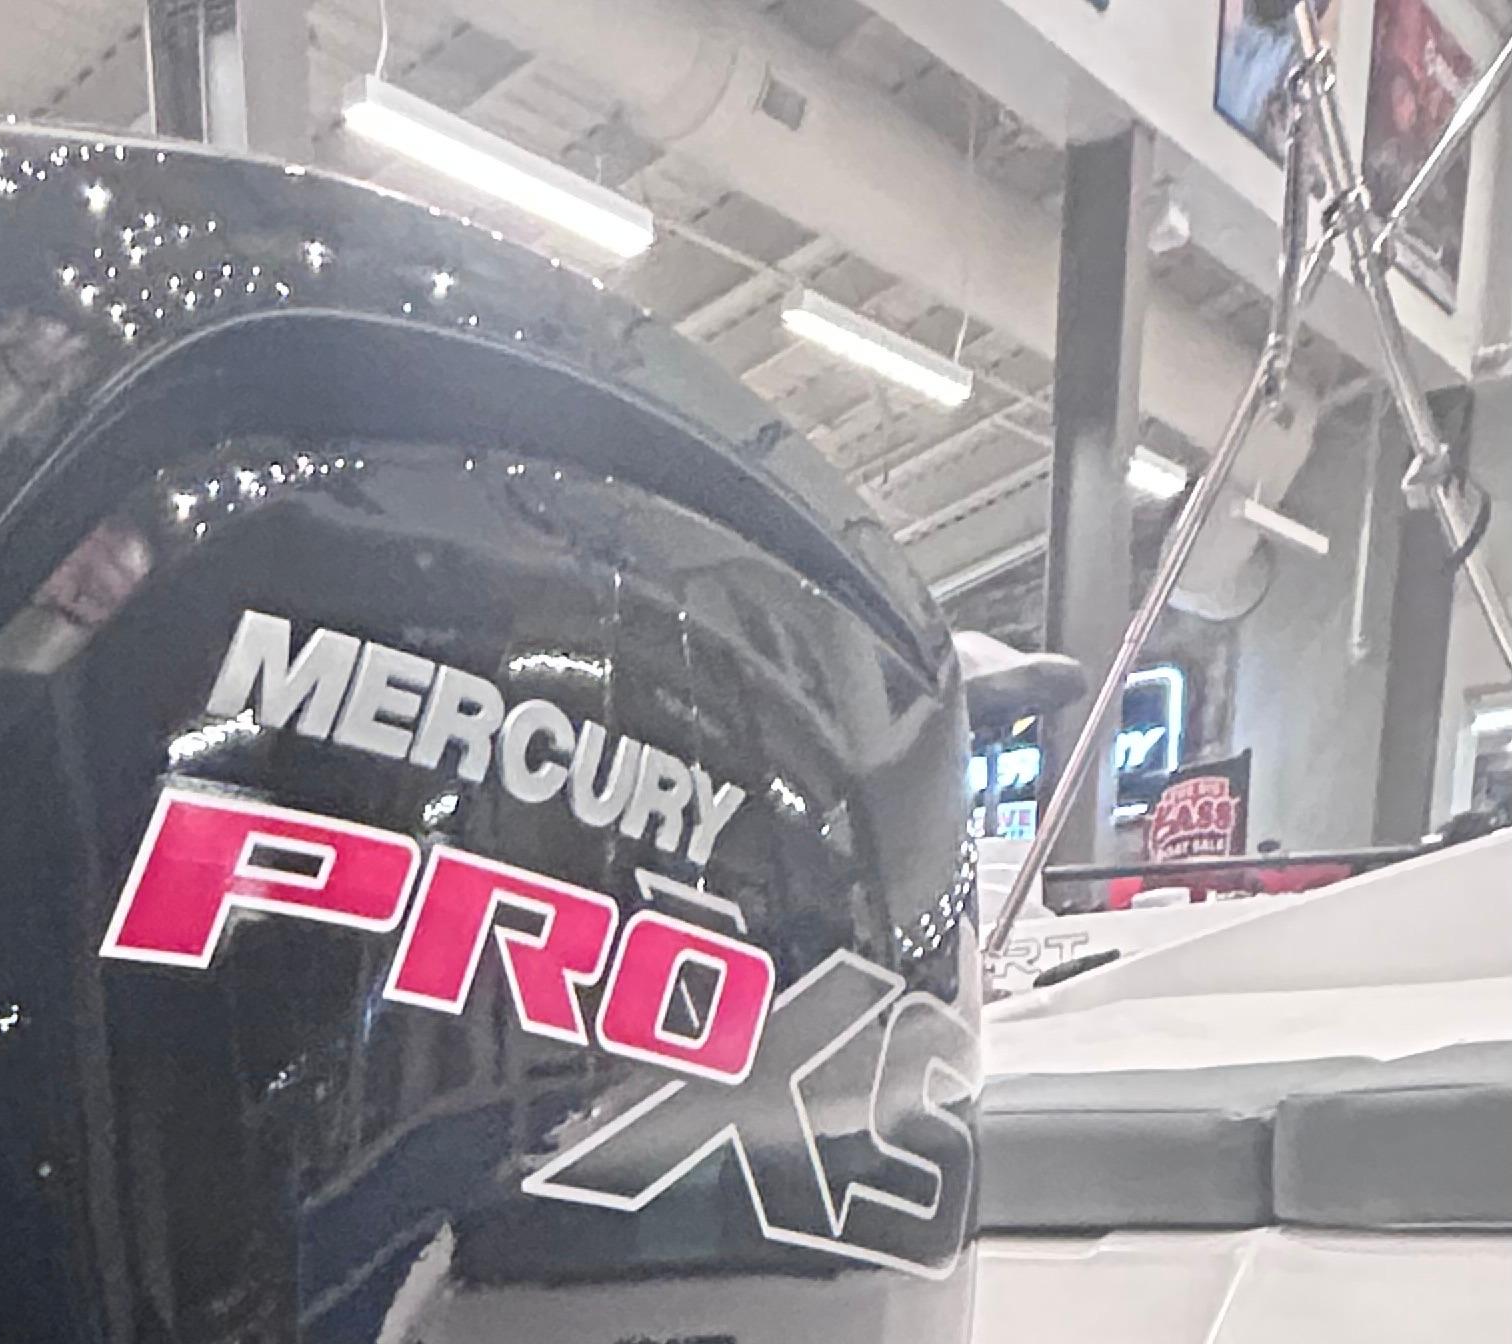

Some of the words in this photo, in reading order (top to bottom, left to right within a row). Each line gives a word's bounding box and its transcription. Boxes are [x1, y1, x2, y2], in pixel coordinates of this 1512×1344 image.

[206, 609, 743, 868] MERCURY
[99, 788, 775, 1086] PRO
[521, 948, 976, 1281] XS
